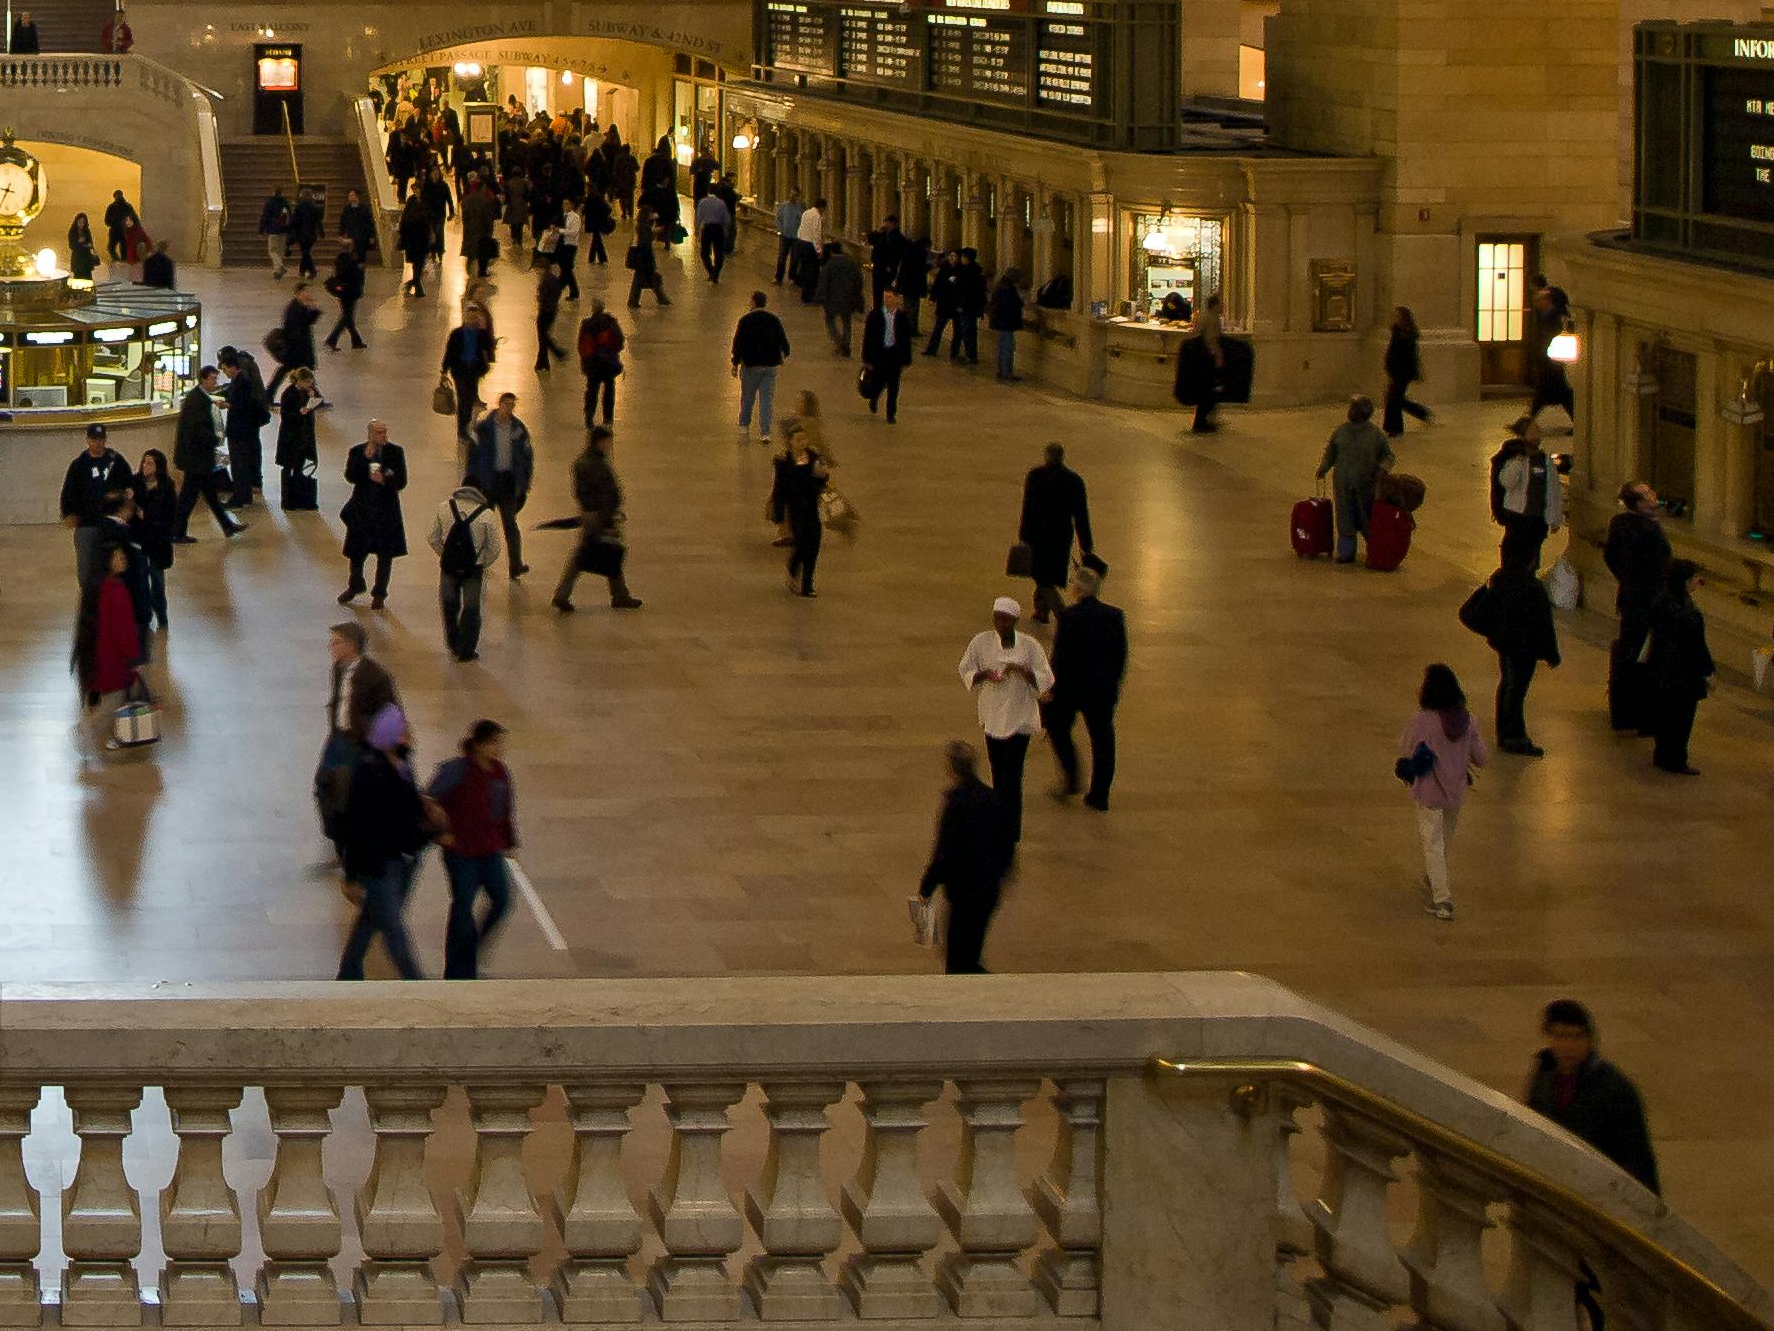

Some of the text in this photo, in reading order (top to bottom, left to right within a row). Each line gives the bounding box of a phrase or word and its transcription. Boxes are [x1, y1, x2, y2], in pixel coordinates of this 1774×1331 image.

[418, 20, 537, 49] LEXINGTON AVE
[587, 20, 649, 37] SUBWAY
[439, 50, 491, 61] PASSAGE
[498, 50, 550, 63] SUBWAY
